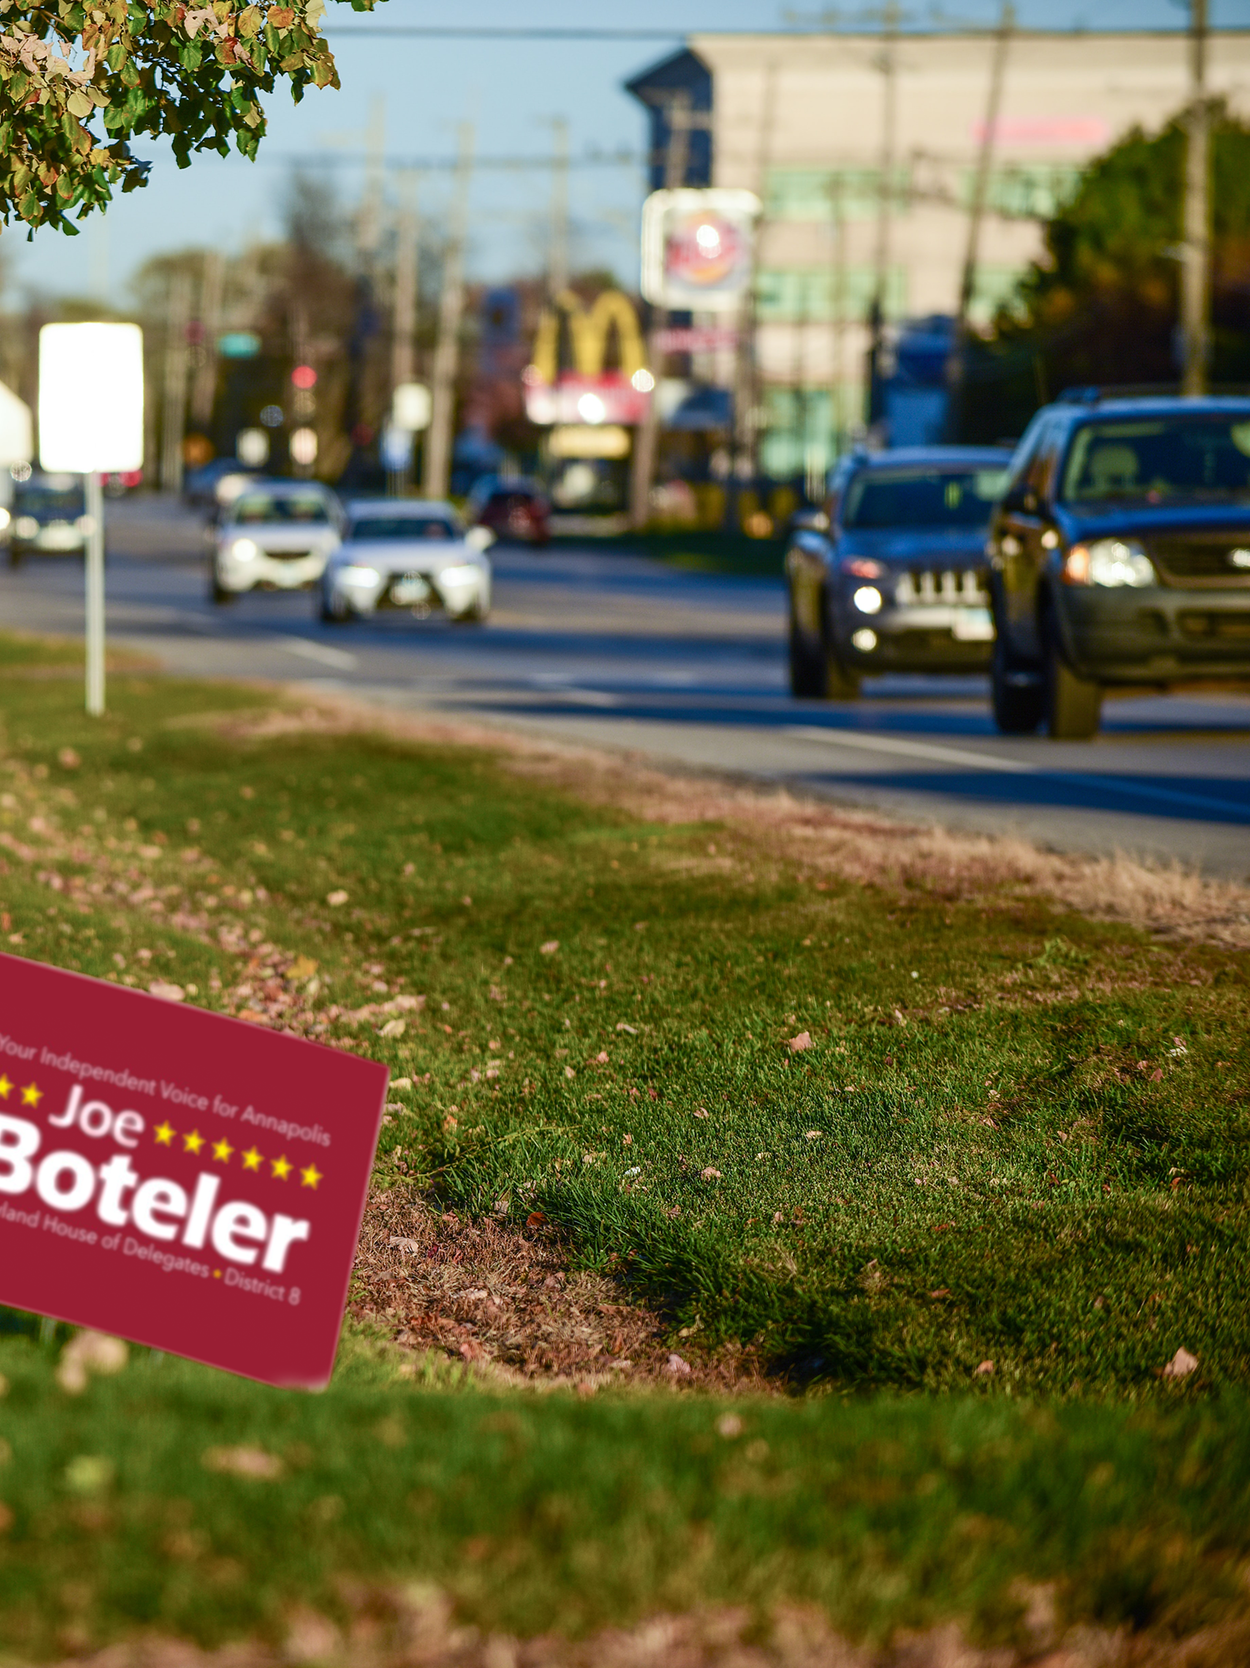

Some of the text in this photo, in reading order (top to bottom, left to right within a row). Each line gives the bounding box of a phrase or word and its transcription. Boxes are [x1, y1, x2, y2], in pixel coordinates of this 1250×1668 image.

[40, 1046, 157, 1096] Independent
[159, 1079, 210, 1111] Voice
[213, 1094, 239, 1119] for
[240, 1105, 331, 1147] Annapolis
[48, 1083, 146, 1148] Joe
[43, 1214, 98, 1245] House
[101, 1233, 122, 1251] of
[123, 1236, 210, 1279] Delegates
[224, 1267, 285, 1301] District
[288, 1286, 302, 1306] 8
